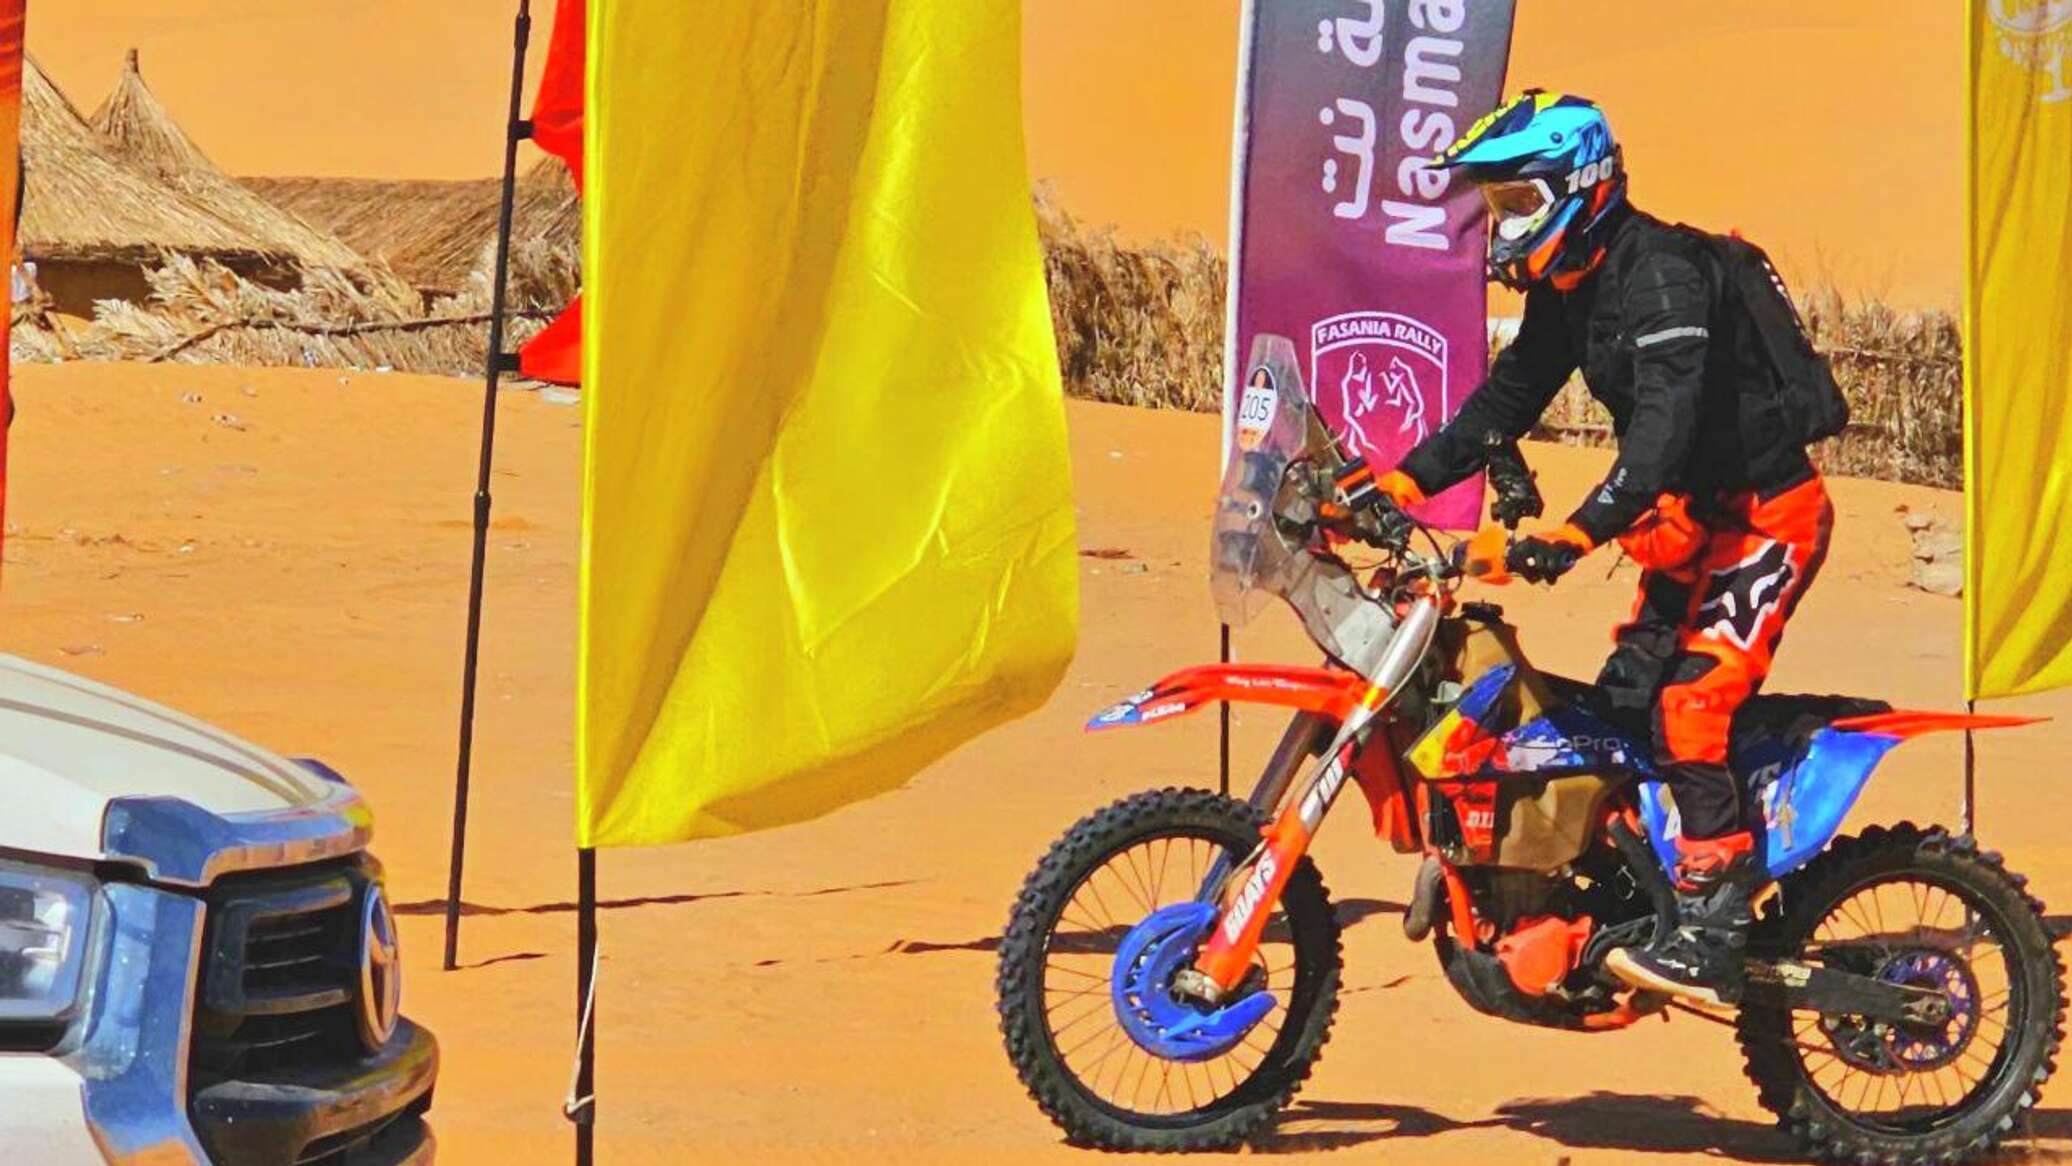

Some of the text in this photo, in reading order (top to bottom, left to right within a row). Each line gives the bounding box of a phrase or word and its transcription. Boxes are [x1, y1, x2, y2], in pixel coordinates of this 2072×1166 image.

[1319, 98, 1377, 219] نت
[1317, 320, 1442, 354] FASANIA RALLY
